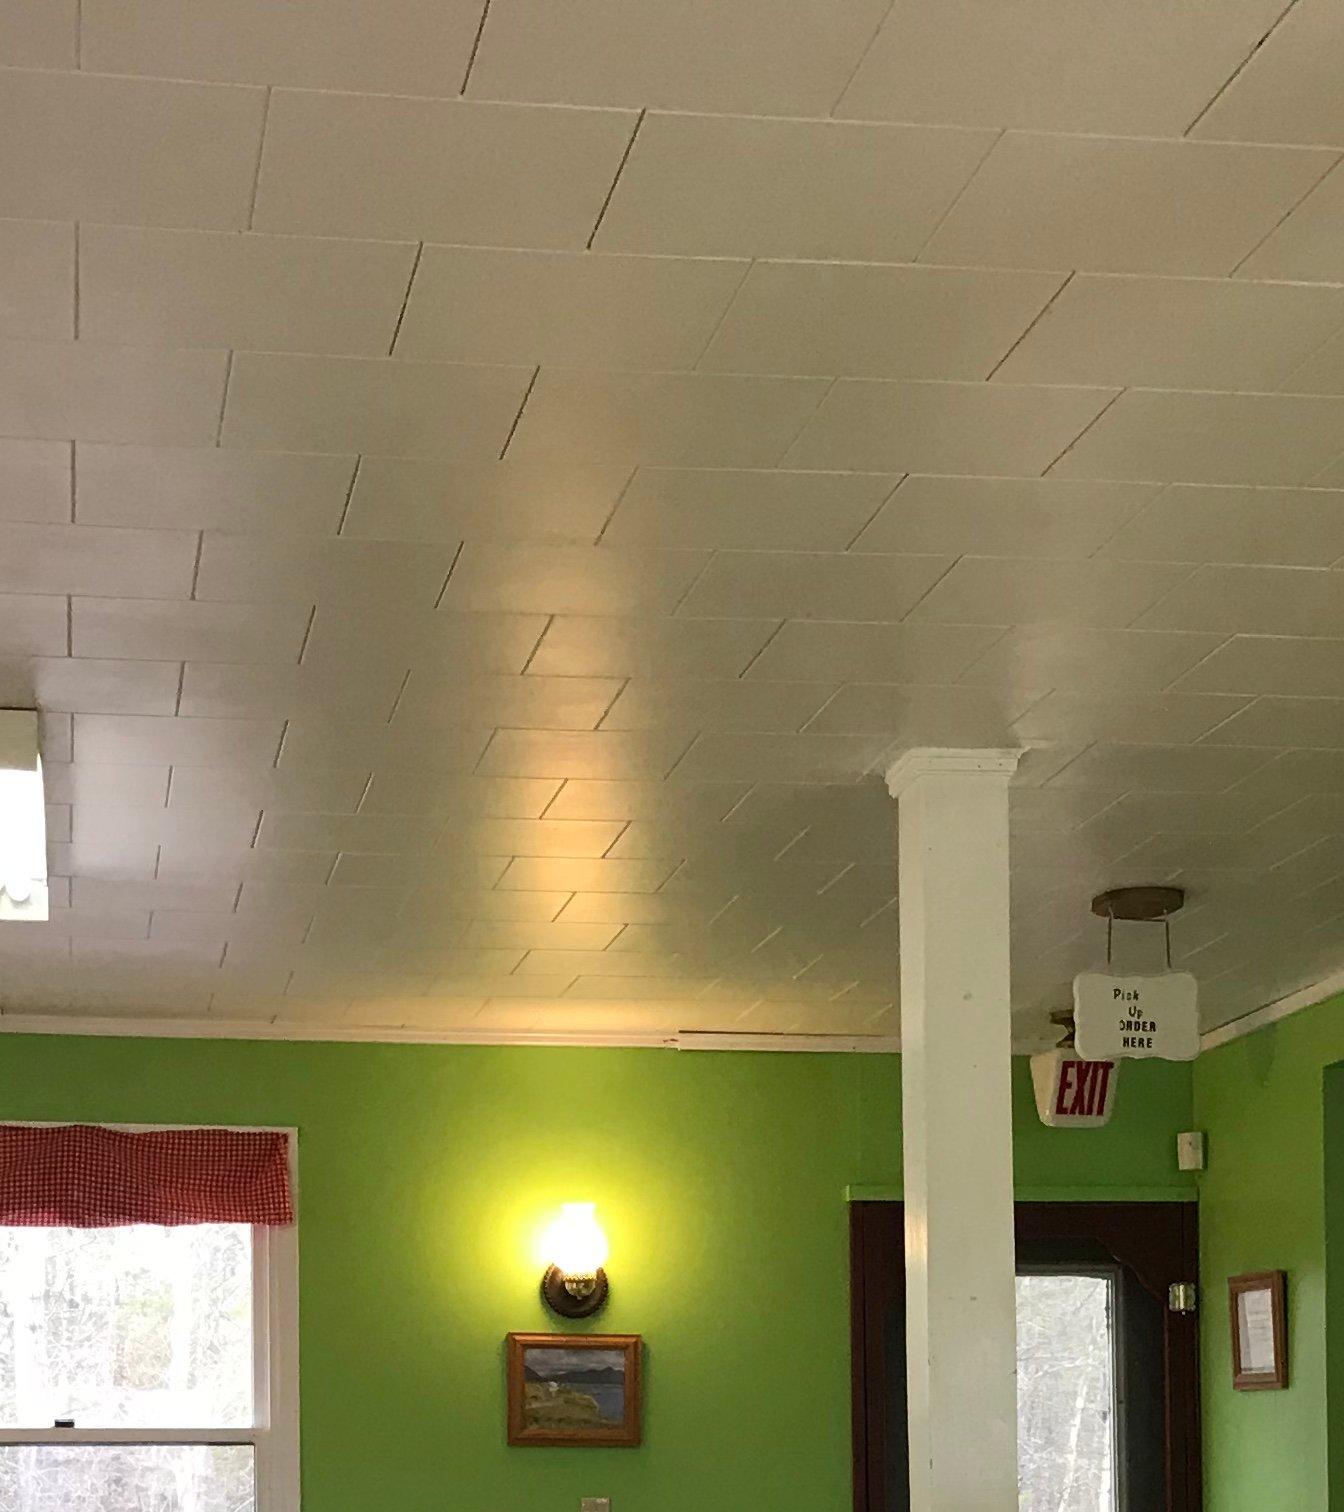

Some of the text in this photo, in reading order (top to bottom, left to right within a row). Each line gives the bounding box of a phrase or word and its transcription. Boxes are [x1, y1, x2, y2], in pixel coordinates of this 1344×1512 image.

[1120, 1020, 1156, 1032] ORDER
[1122, 1037, 1153, 1049] HERE
[1056, 1060, 1114, 1116] EXIT
